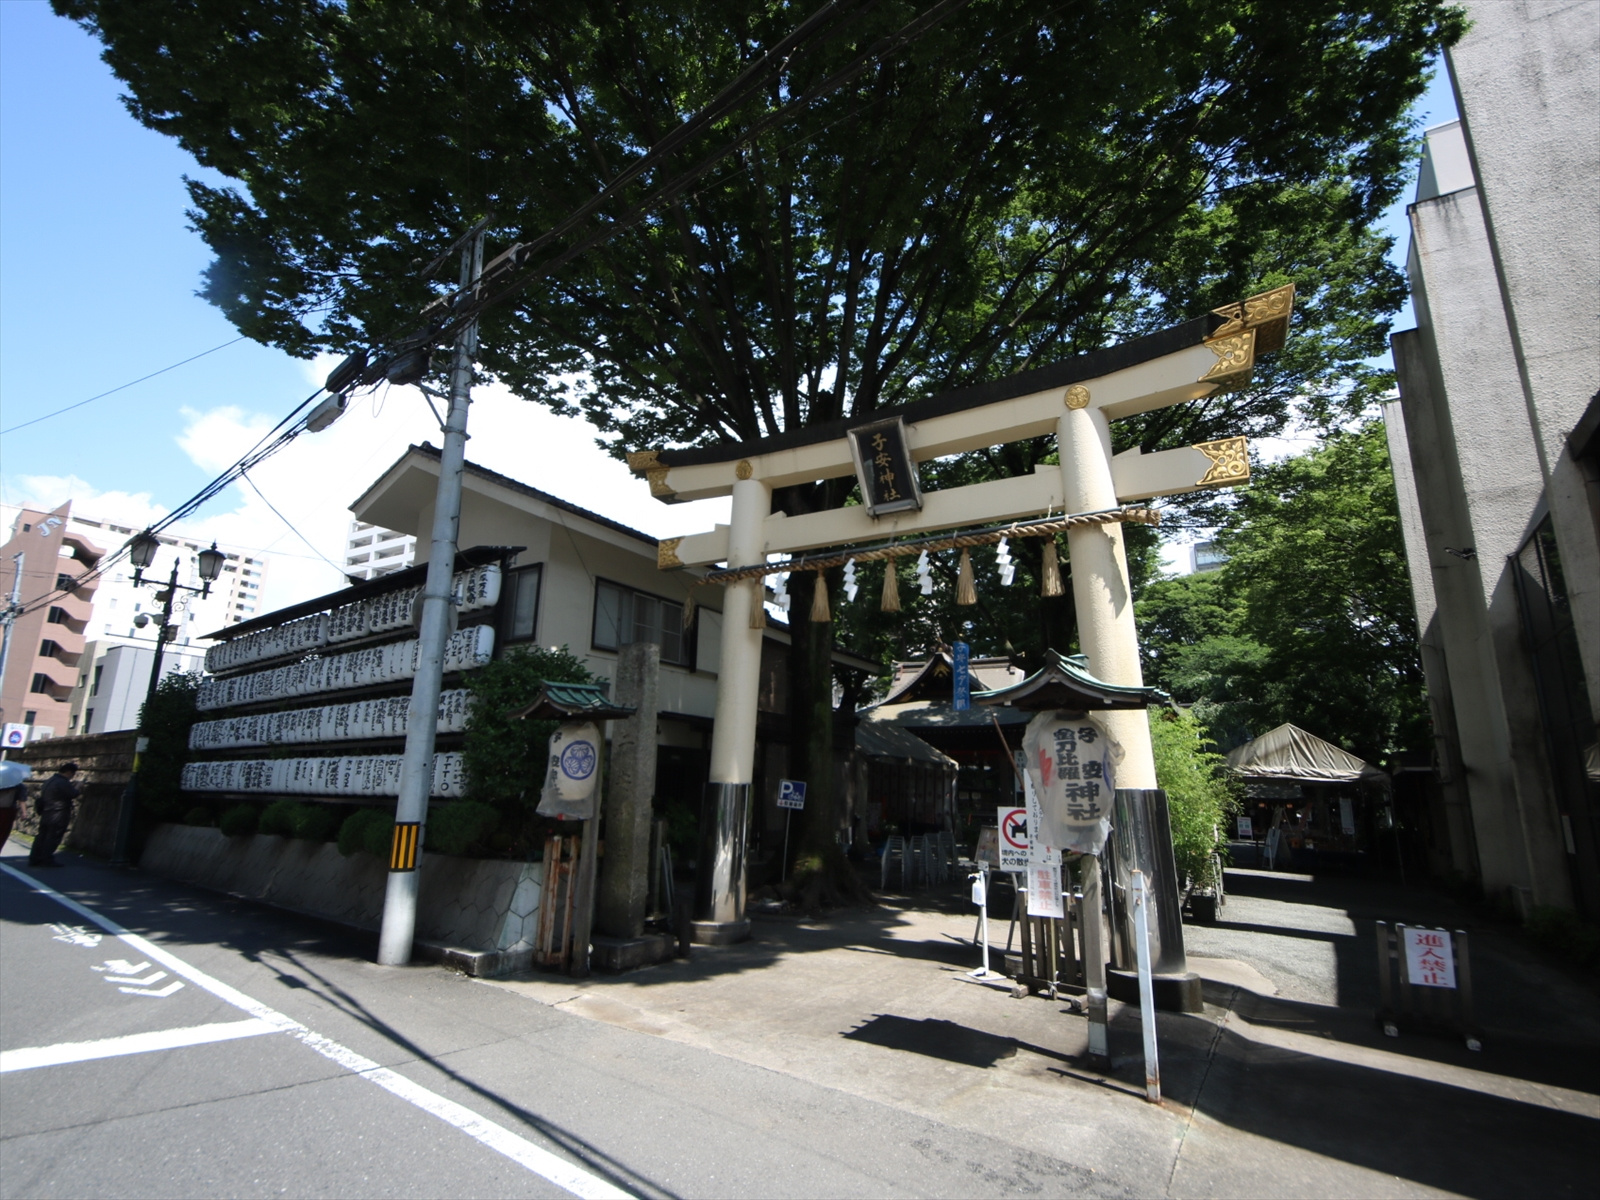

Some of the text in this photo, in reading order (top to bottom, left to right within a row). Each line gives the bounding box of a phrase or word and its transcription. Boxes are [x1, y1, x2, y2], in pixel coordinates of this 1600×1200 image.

[871, 433, 901, 502] 子安神社
[1053, 727, 1080, 780] 金刀比羅
[1078, 727, 1102, 780] 子安
[780, 781, 794, 799] P
[1065, 781, 1101, 821] 神社
[1037, 870, 1053, 911] 駐車禁止
[1415, 934, 1448, 986] 進入禁止
